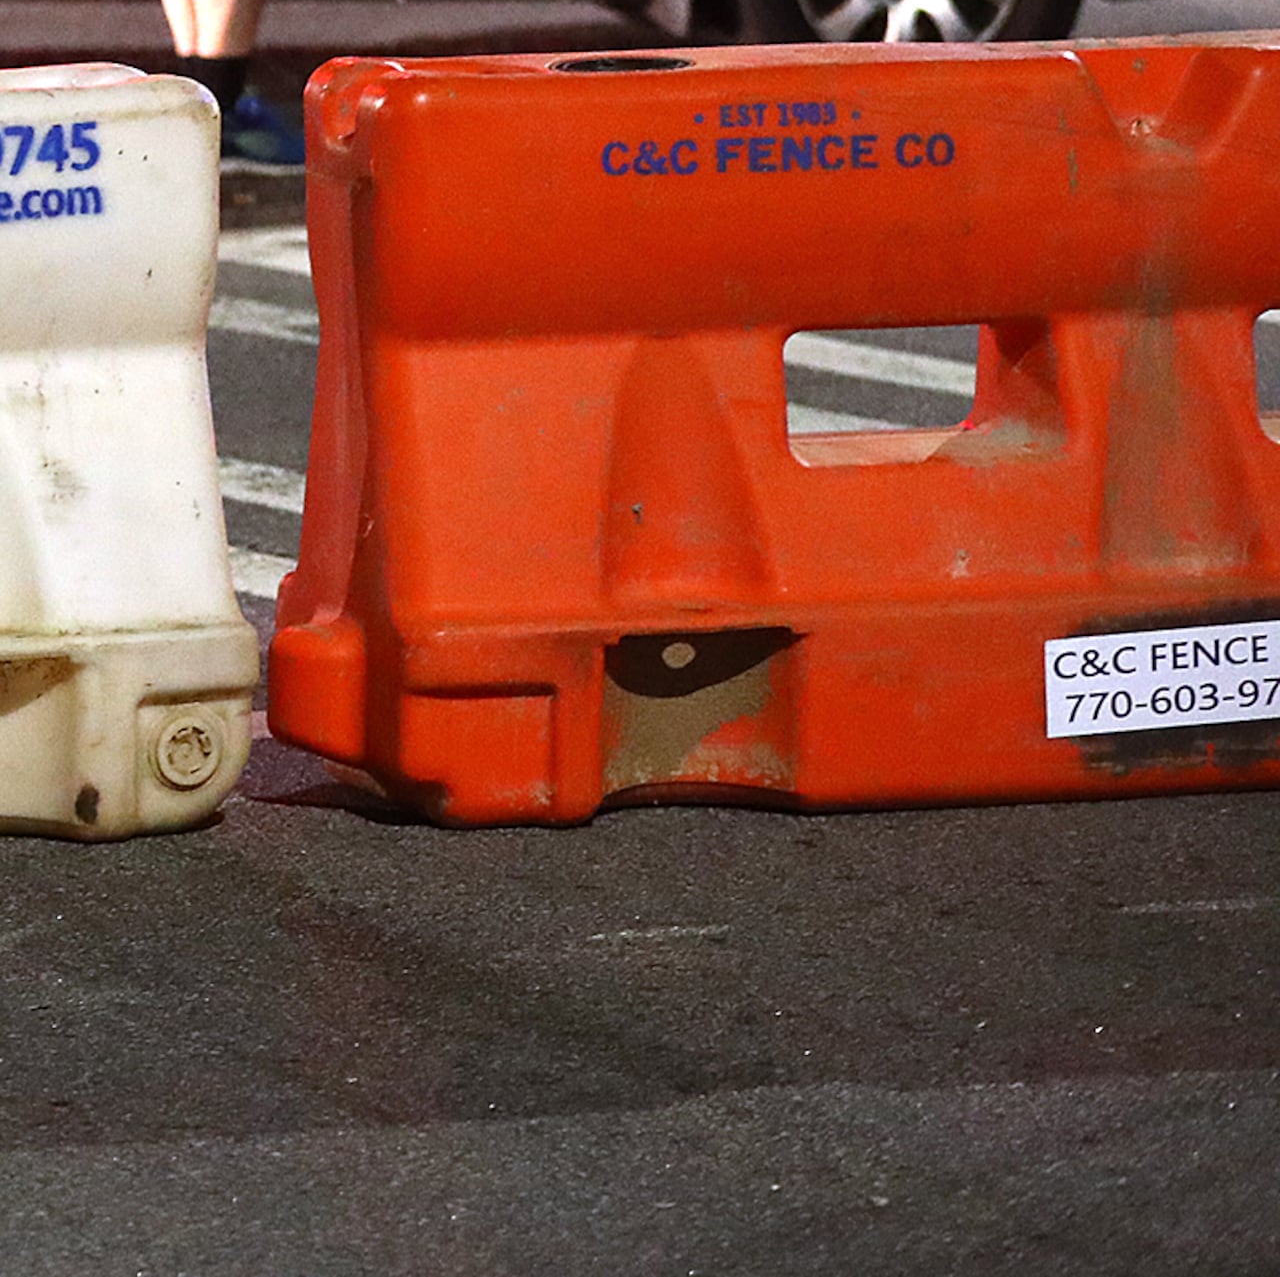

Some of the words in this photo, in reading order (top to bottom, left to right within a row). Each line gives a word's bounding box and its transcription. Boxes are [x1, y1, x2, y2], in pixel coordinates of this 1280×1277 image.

[720, 103, 769, 127] EST
[601, 140, 699, 175] C&C
[715, 134, 879, 172] FENCE
[895, 132, 956, 168] CO
[1053, 649, 1138, 680] C&C
[1151, 635, 1270, 672] FENCE
